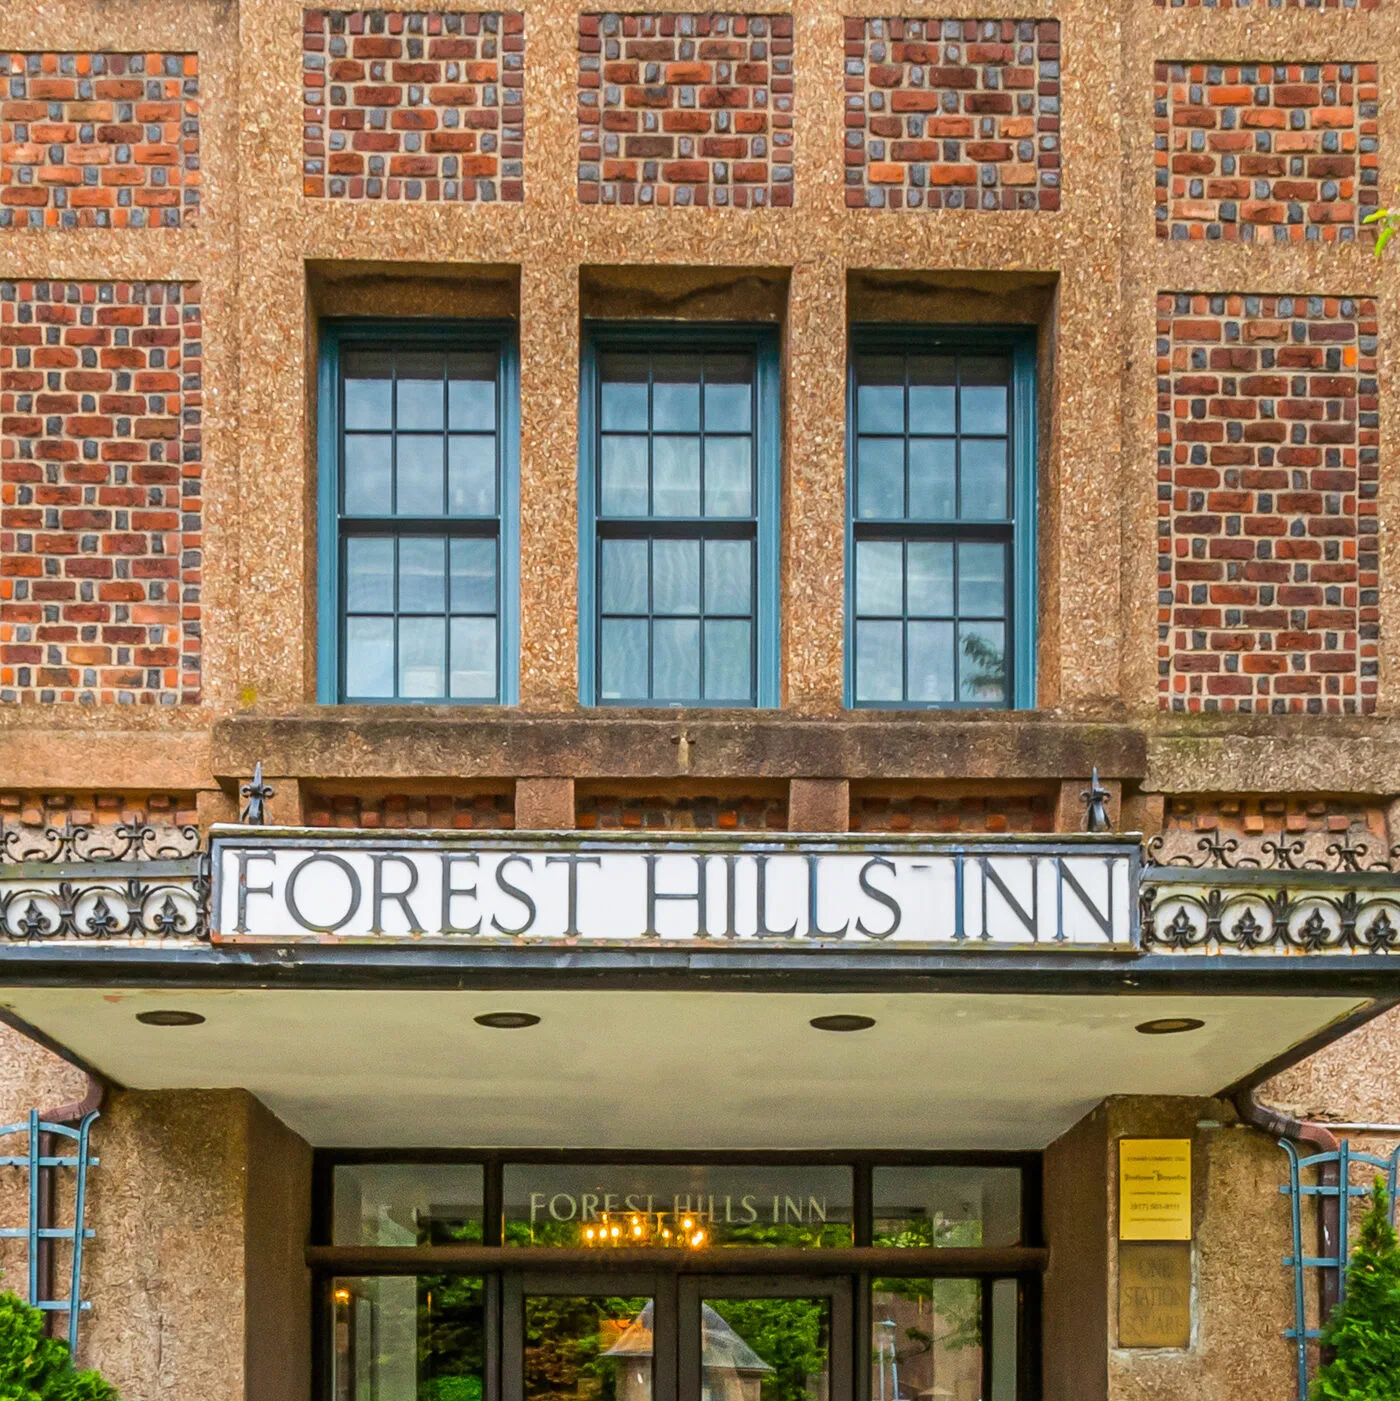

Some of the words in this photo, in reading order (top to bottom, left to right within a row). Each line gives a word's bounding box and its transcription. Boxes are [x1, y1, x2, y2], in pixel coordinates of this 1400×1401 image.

[230, 850, 601, 938] FOREST
[641, 853, 902, 941] HILLS
[949, 854, 1115, 944] INN
[529, 1192, 656, 1222] FOREST
[673, 1193, 759, 1223] HILLS
[772, 1193, 828, 1223] INN
